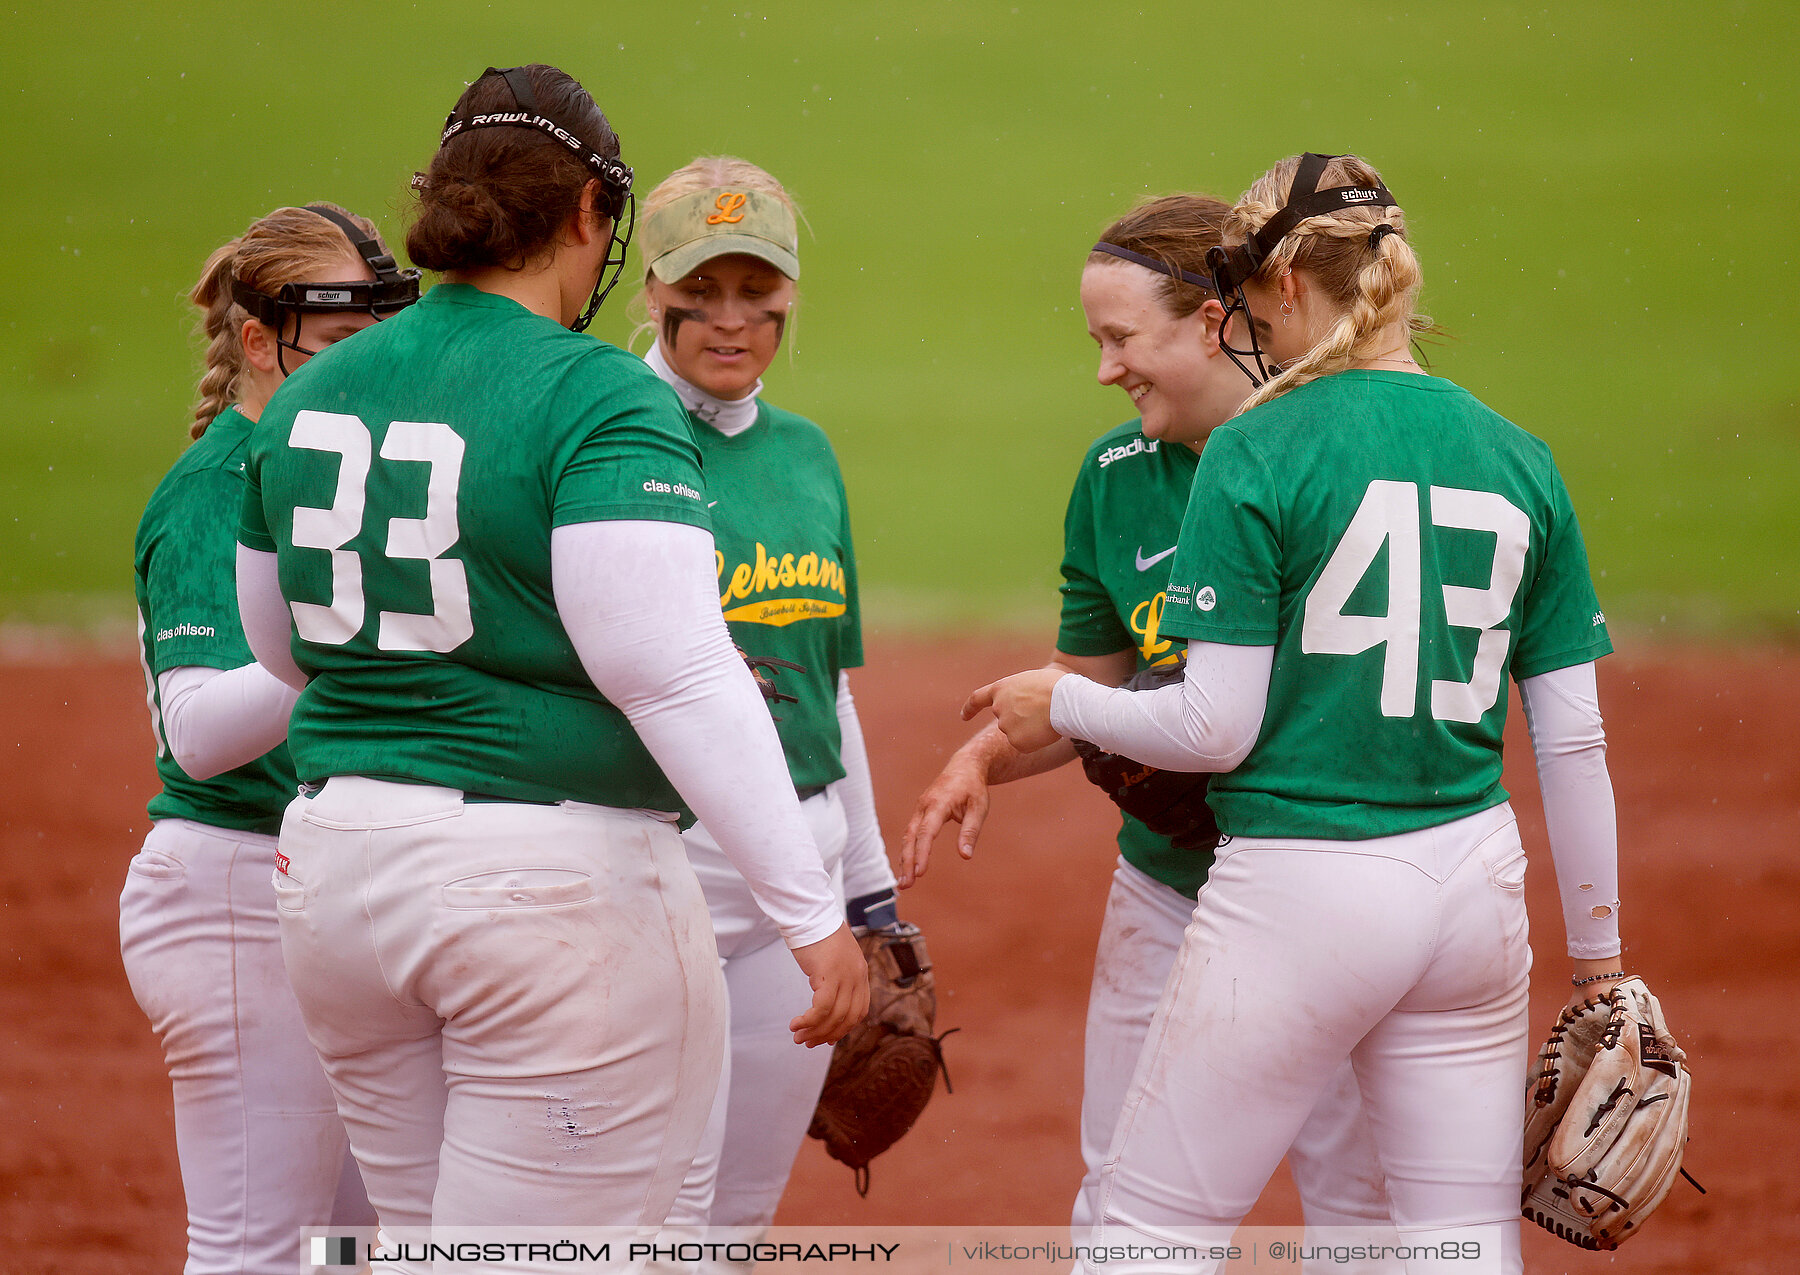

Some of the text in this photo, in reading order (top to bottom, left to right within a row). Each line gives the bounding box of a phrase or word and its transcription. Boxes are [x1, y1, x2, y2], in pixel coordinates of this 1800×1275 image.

[472, 112, 582, 150] RAWLINGS
[1341, 187, 1379, 200] schutt
[706, 192, 747, 225] L
[317, 291, 340, 299] schutt
[643, 479, 701, 501] clas ohlson
[288, 409, 475, 654] 33
[1302, 479, 1531, 724] 43
[156, 622, 215, 642] clas ohlson
